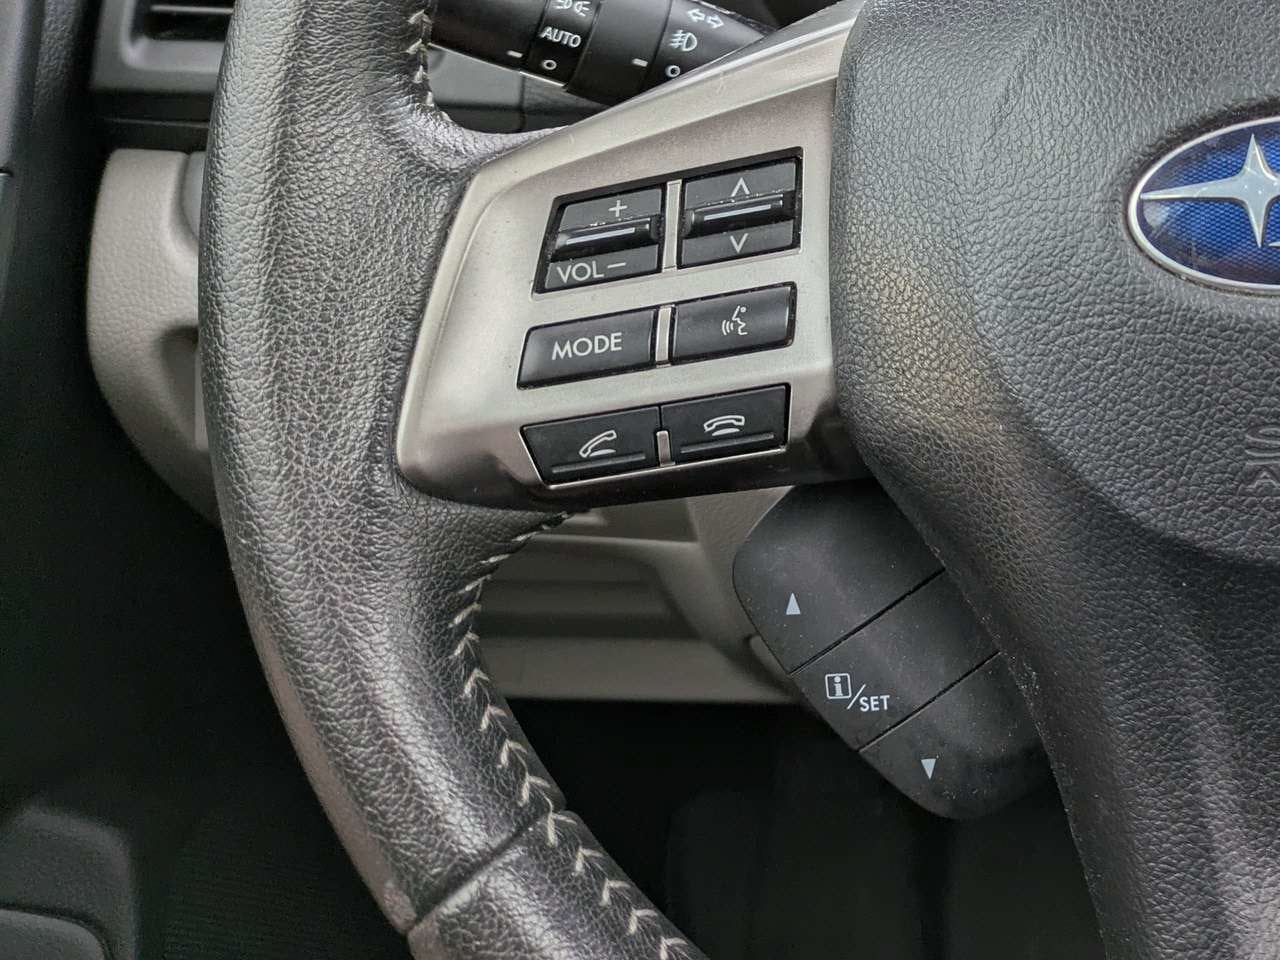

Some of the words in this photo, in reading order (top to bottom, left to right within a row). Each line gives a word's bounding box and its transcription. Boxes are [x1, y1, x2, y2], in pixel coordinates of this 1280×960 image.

[539, 25, 582, 49] AUTO
[556, 264, 605, 284] VOL
[551, 332, 623, 361] MODE
